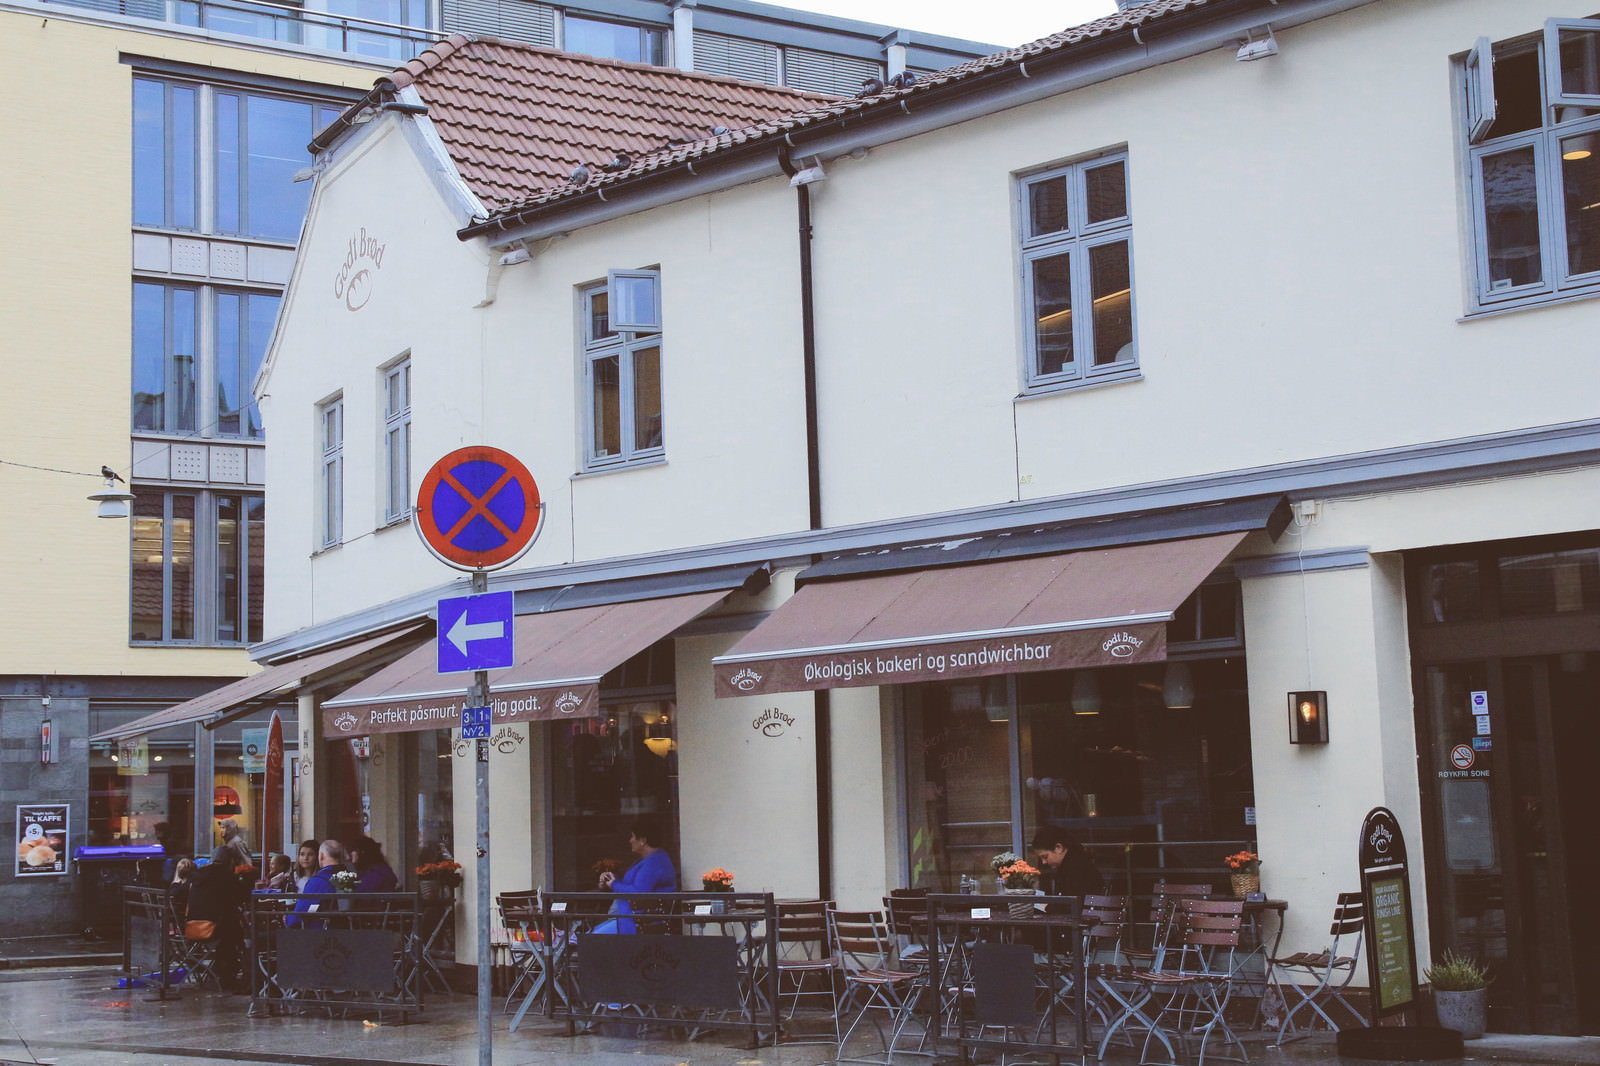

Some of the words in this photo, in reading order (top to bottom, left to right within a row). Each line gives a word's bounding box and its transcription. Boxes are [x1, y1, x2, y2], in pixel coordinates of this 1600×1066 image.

[334, 232, 358, 299] Godt
[1102, 632, 1121, 651] Godt
[804, 657, 872, 682] Økologisk
[876, 653, 922, 674] bakeri
[927, 654, 945, 672] og
[950, 642, 1052, 667] sandwichbar
[731, 668, 746, 685] Godt
[370, 707, 407, 724] Perfekt
[410, 703, 458, 725] påsmurt.
[510, 695, 541, 716] godt.
[752, 708, 772, 729] Godt
[490, 728, 506, 746] Godt
[1438, 770, 1468, 778] RØYKFRI
[1470, 769, 1490, 777] SONE
[24, 815, 36, 823] TIL
